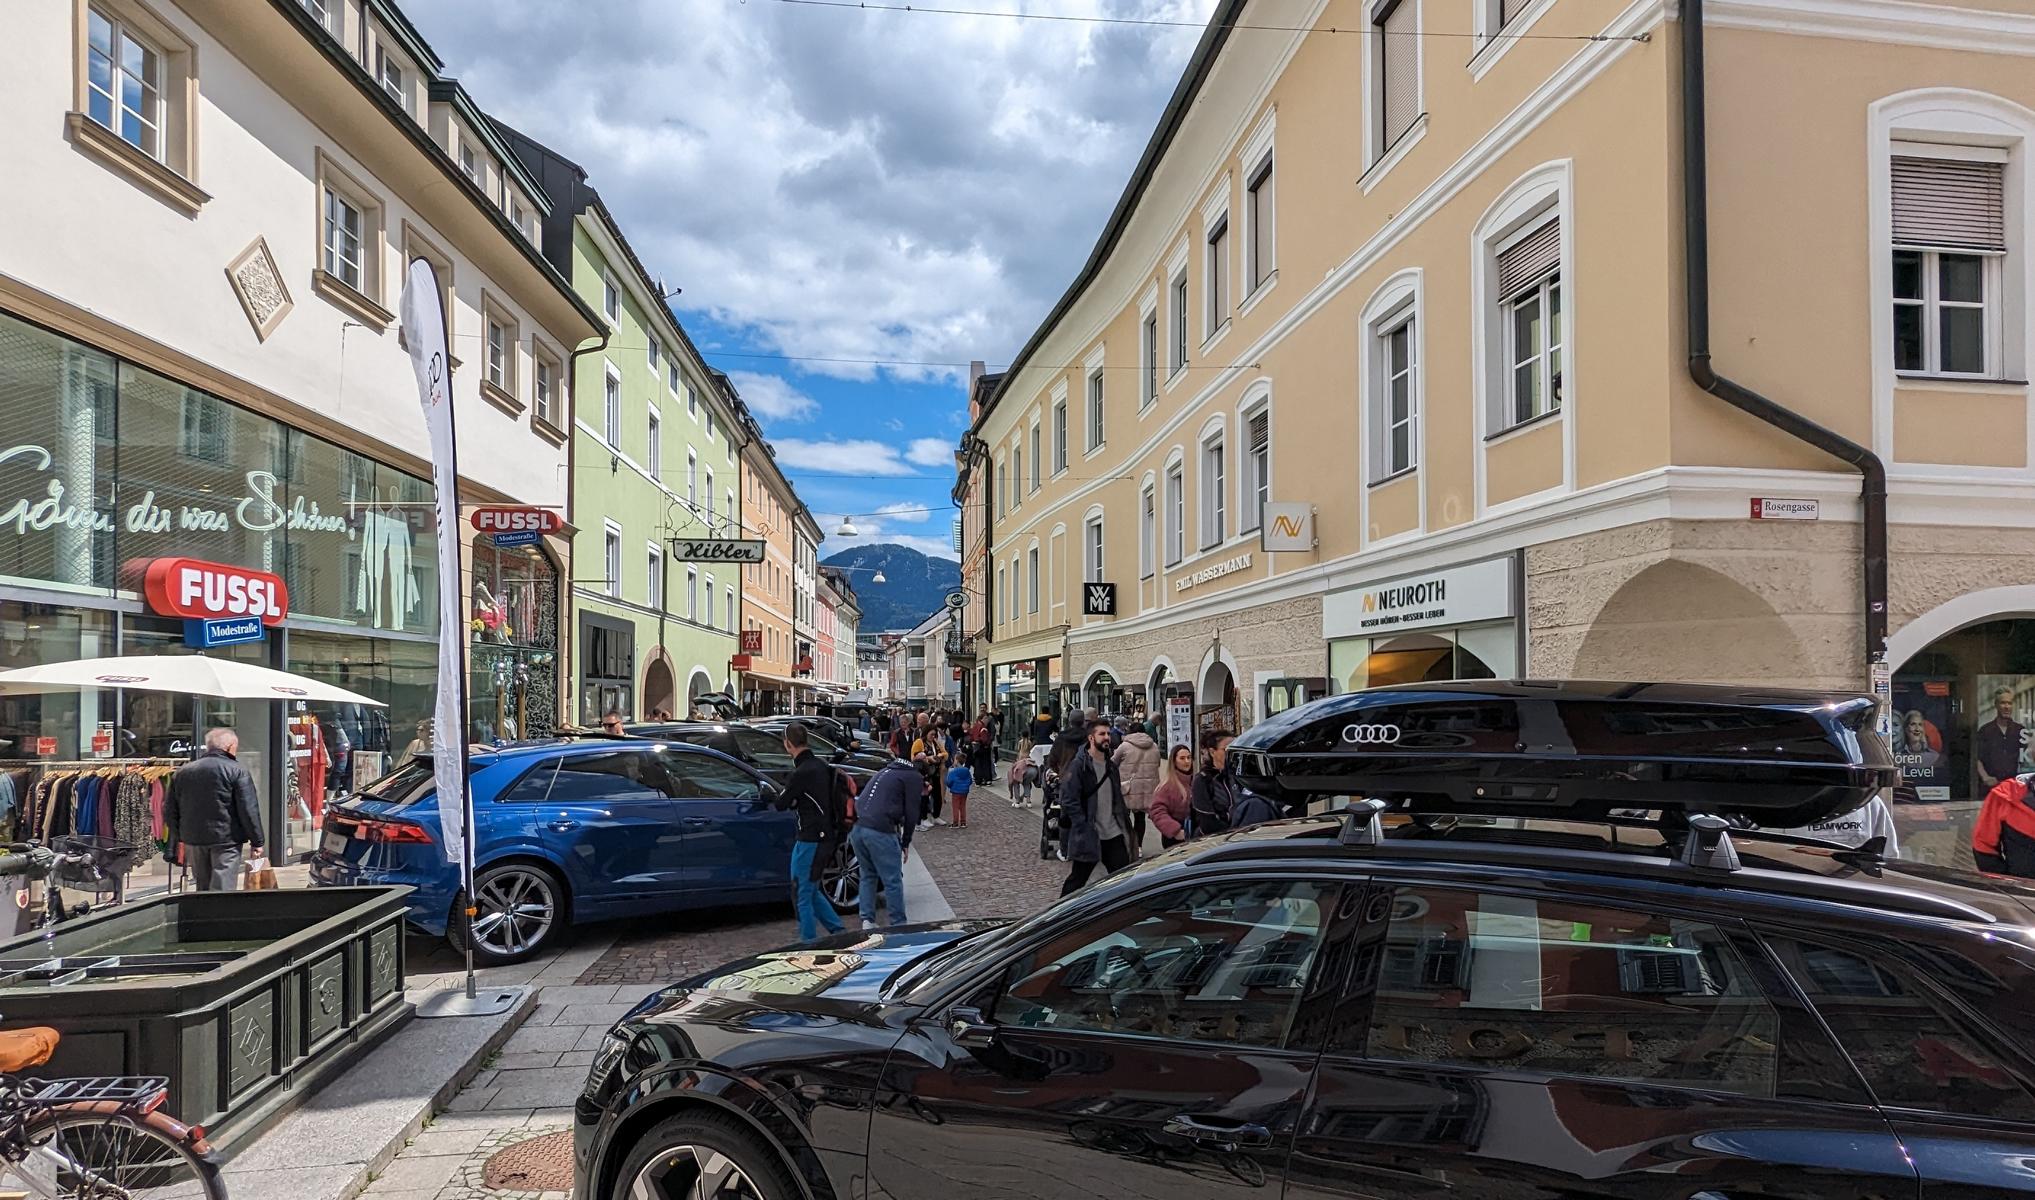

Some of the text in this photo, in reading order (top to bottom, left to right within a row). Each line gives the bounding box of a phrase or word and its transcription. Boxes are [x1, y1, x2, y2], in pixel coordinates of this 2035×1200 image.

[1765, 501, 1815, 513] Rosengasse
[179, 505, 230, 533] was
[479, 511, 551, 529] FUSSL
[683, 542, 754, 559] Hibler
[1176, 553, 1252, 592] EMIL WASSERMANN
[181, 567, 281, 616] FUSSL
[1379, 579, 1445, 610] NEUROTH
[1403, 611, 1424, 622] BESSER
[211, 622, 258, 637] Modestraße
[1891, 751, 1922, 764] ören
[1903, 765, 1934, 778] Level
[1807, 821, 1863, 833] TEAMWORK
